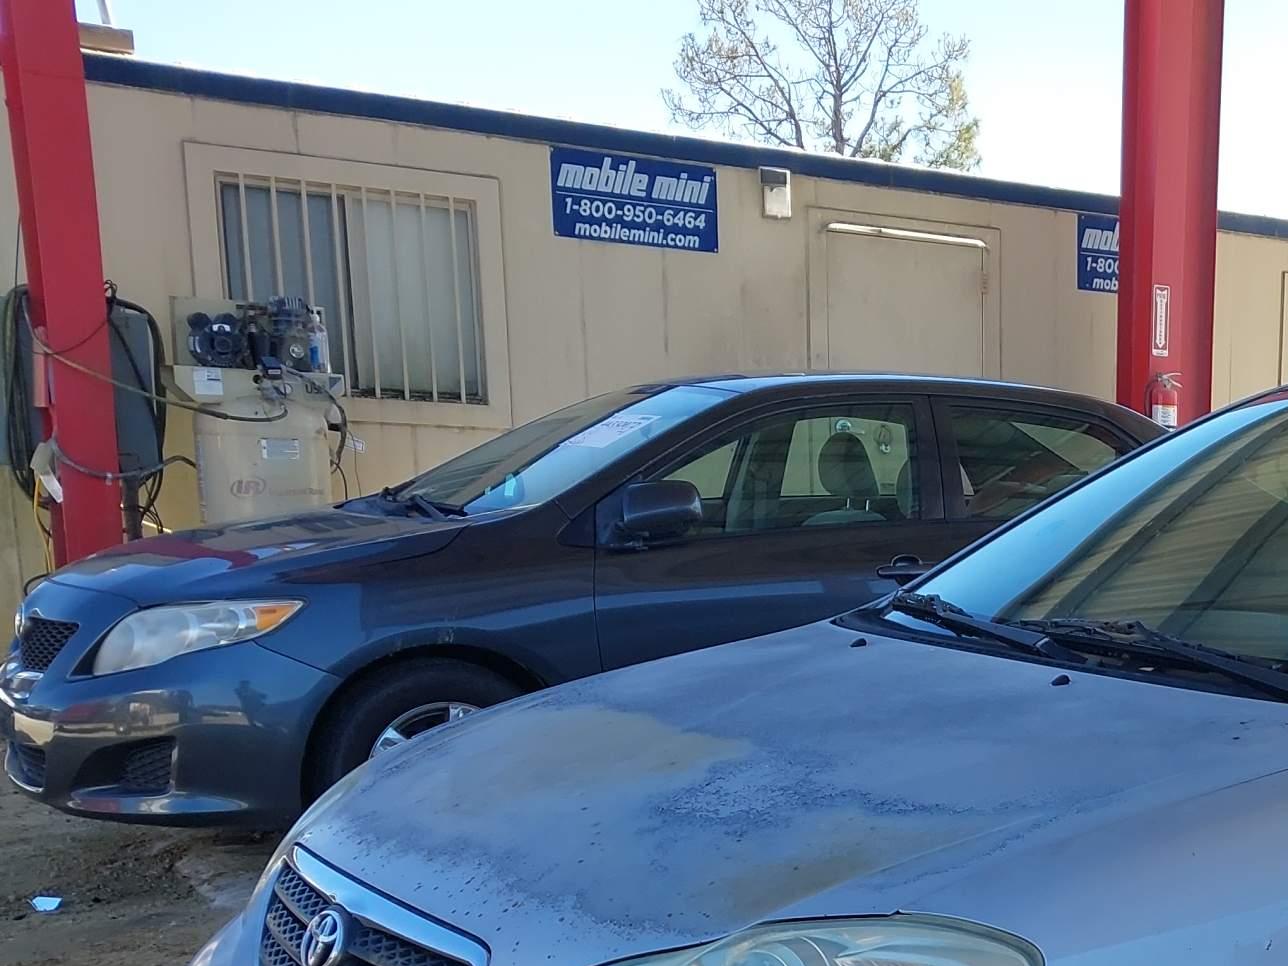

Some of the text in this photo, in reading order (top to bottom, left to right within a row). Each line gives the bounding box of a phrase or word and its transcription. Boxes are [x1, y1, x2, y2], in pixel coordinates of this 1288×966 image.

[556, 157, 711, 205] mobile mini
[565, 197, 706, 229] 1-800-950-6464
[574, 222, 700, 248] mobilemini.com
